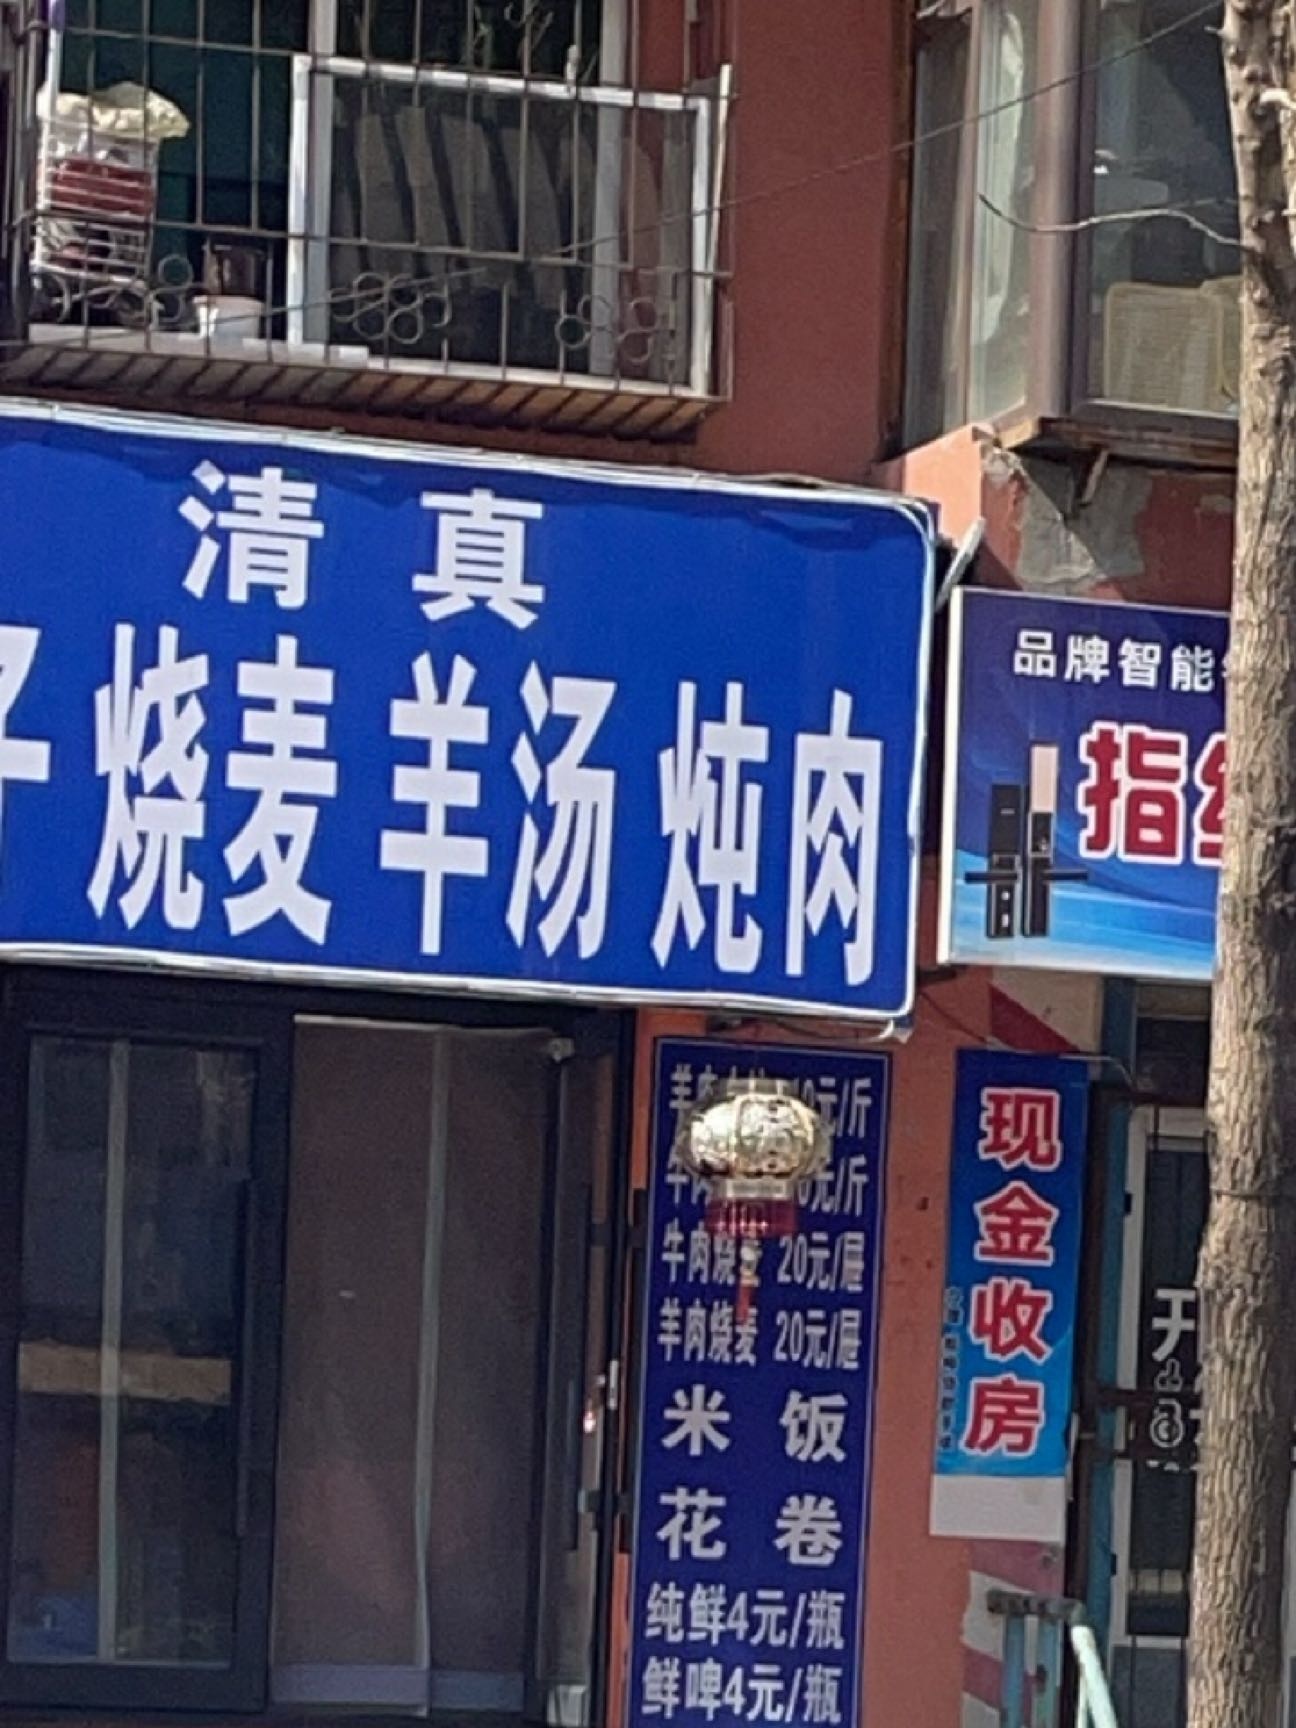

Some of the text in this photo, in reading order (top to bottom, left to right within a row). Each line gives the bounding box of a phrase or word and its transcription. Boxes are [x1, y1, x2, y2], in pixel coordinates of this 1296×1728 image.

[179, 459, 546, 630] 清真
[964, 1085, 1062, 1457] 现金收房
[661, 1383, 849, 1462] 米饭
[656, 1487, 843, 1566] 花卷
[645, 1581, 846, 1650] 纯鲜4元/瓶
[641, 1655, 843, 1725] 鲜啤4元/瓶
